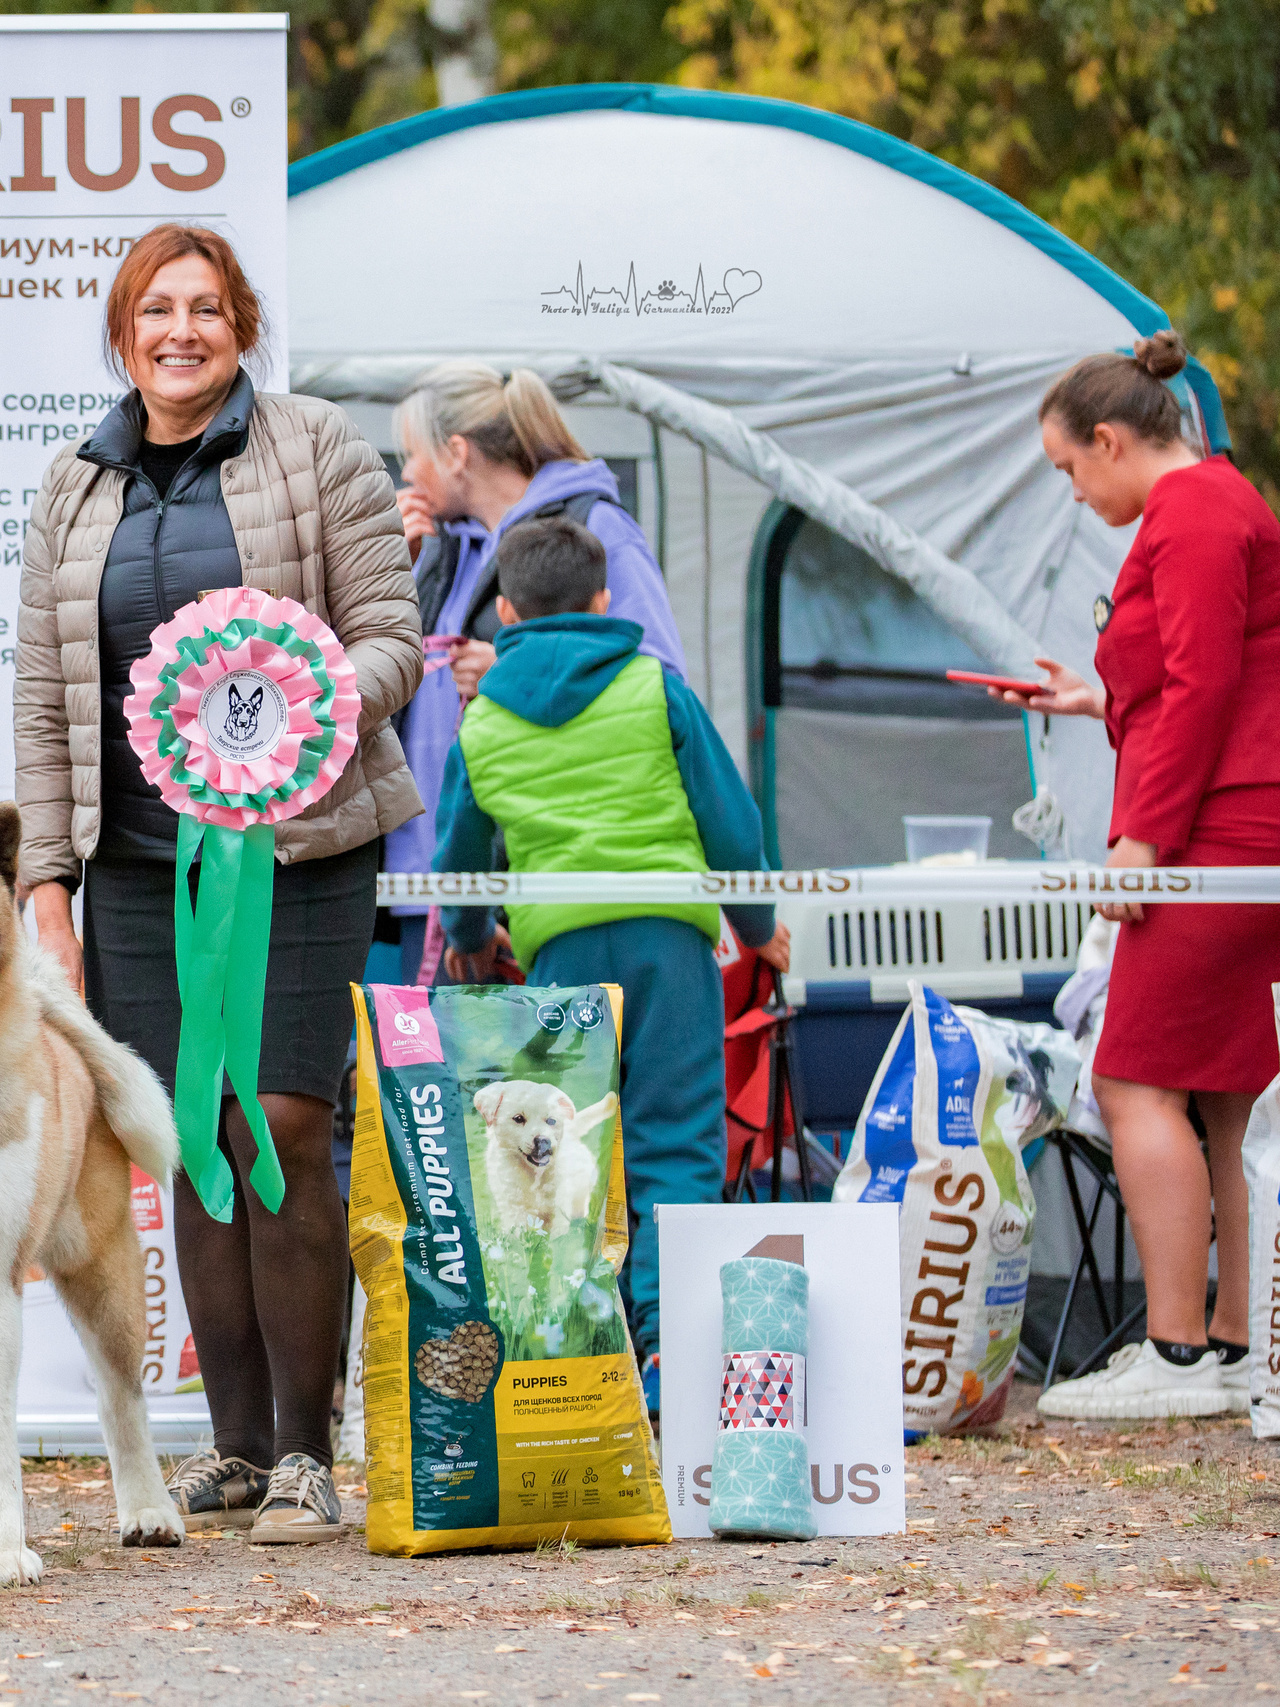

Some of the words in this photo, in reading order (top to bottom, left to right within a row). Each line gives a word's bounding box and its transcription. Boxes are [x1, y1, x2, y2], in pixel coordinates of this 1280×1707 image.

[77, 277, 98, 298] и
[3, 391, 122, 419] содерж
[229, 672, 264, 682] Служебного
[393, 1086, 402, 1103] for
[397, 1107, 410, 1132] food
[403, 1137, 416, 1156] pet
[410, 1083, 458, 1219] PUPPIES
[407, 1161, 422, 1213] premium
[133, 1198, 156, 1210] DULT
[433, 1225, 468, 1285] ALL
[903, 1172, 985, 1398] SIRIUS
[513, 1376, 567, 1389] PUPPIES
[602, 1371, 619, 1383] 2-12
[513, 1399, 530, 1407] ДЛЯ
[531, 1397, 561, 1406] ЩЕНКОВ
[581, 1394, 602, 1402] ПОРОД
[514, 1404, 568, 1416] ПОЛНОЦЕННЫЙ
[570, 1403, 596, 1412] РАЦИОН
[579, 1436, 600, 1444] CHICKEN
[430, 1462, 454, 1471] COMBINE
[455, 1460, 478, 1469] FEEDING
[626, 1489, 633, 1498] kg
[677, 1465, 685, 1506] PREMIUM
